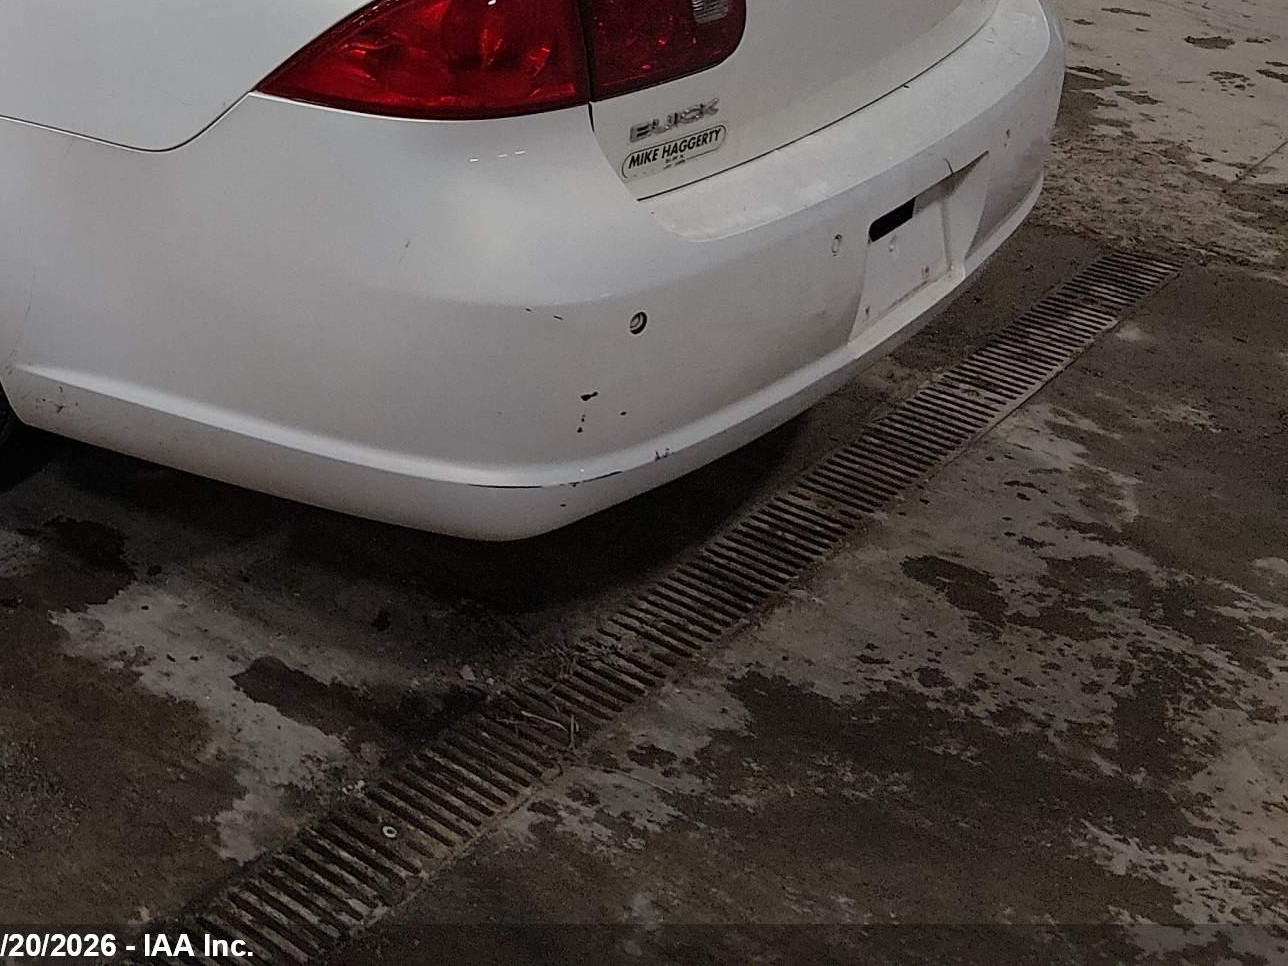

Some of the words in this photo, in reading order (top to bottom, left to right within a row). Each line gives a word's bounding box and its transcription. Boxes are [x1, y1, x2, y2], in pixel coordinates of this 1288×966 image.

[629, 97, 720, 143] BUICK
[628, 148, 660, 170] MIKE
[661, 128, 722, 159] HAGGERTY
